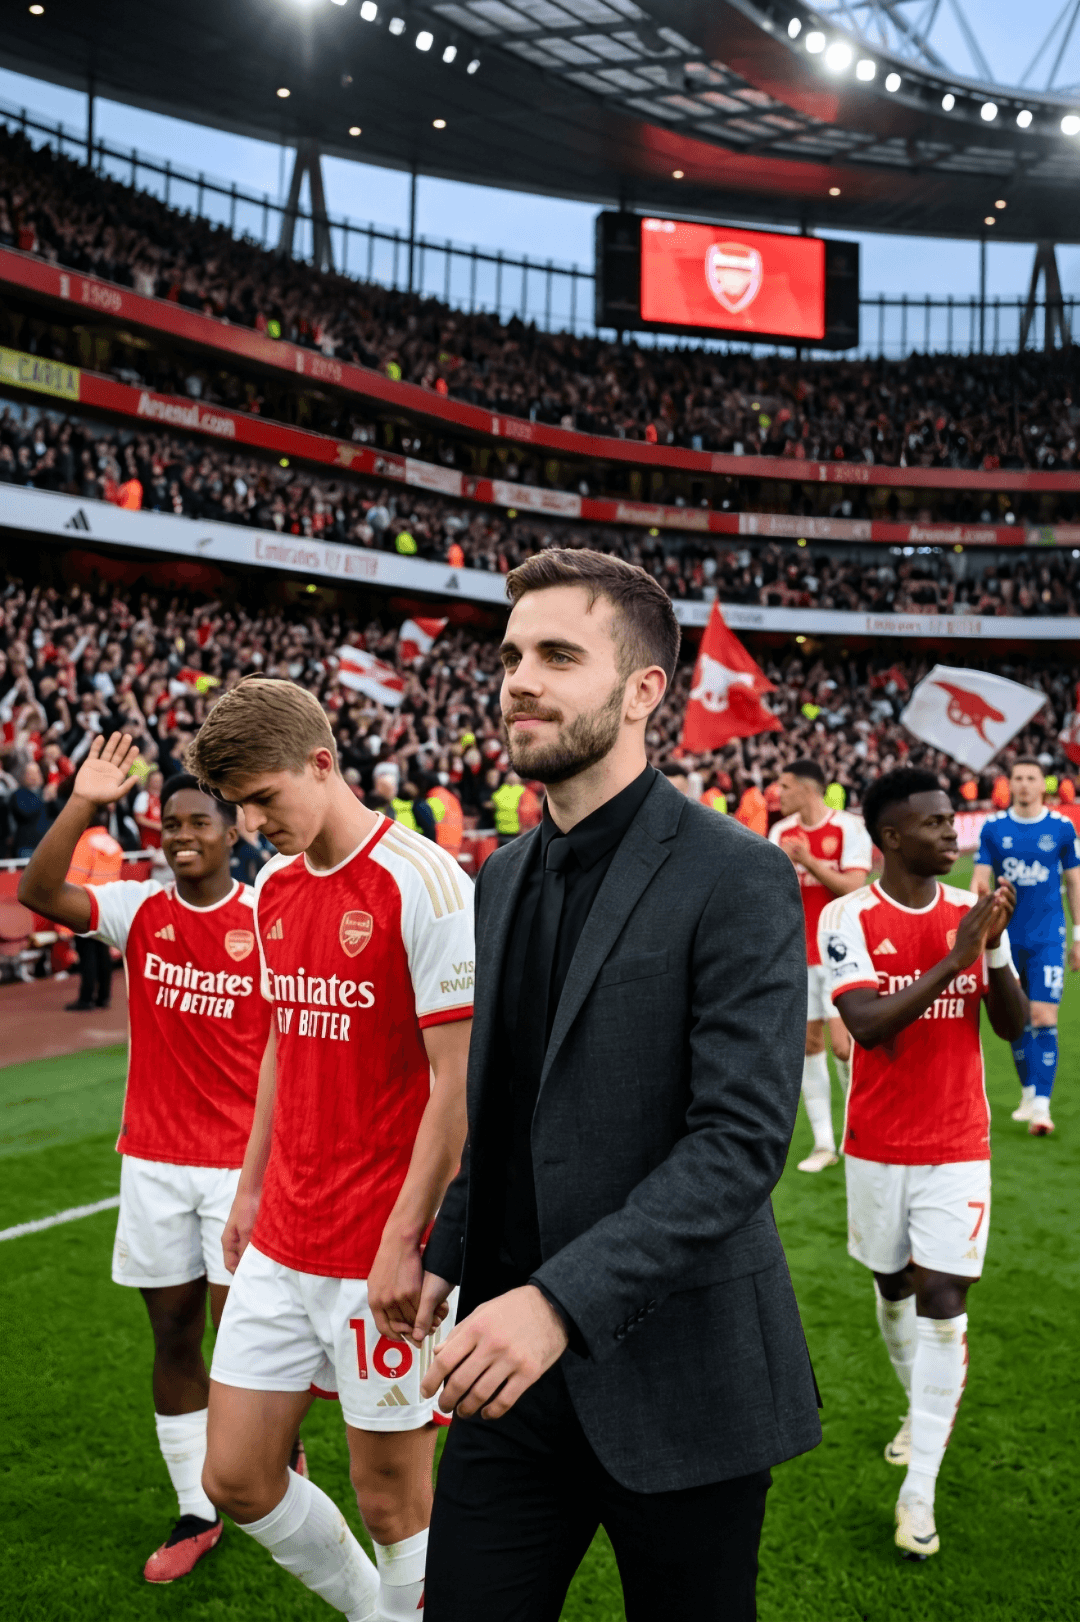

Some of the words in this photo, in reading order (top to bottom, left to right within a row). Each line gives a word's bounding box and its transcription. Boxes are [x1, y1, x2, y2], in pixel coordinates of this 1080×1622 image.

[144, 952, 254, 996] Emirates
[261, 967, 376, 1008] Emirates
[180, 992, 235, 1019] BETTER
[967, 1202, 985, 1241] 7
[349, 1318, 414, 1380] 16
